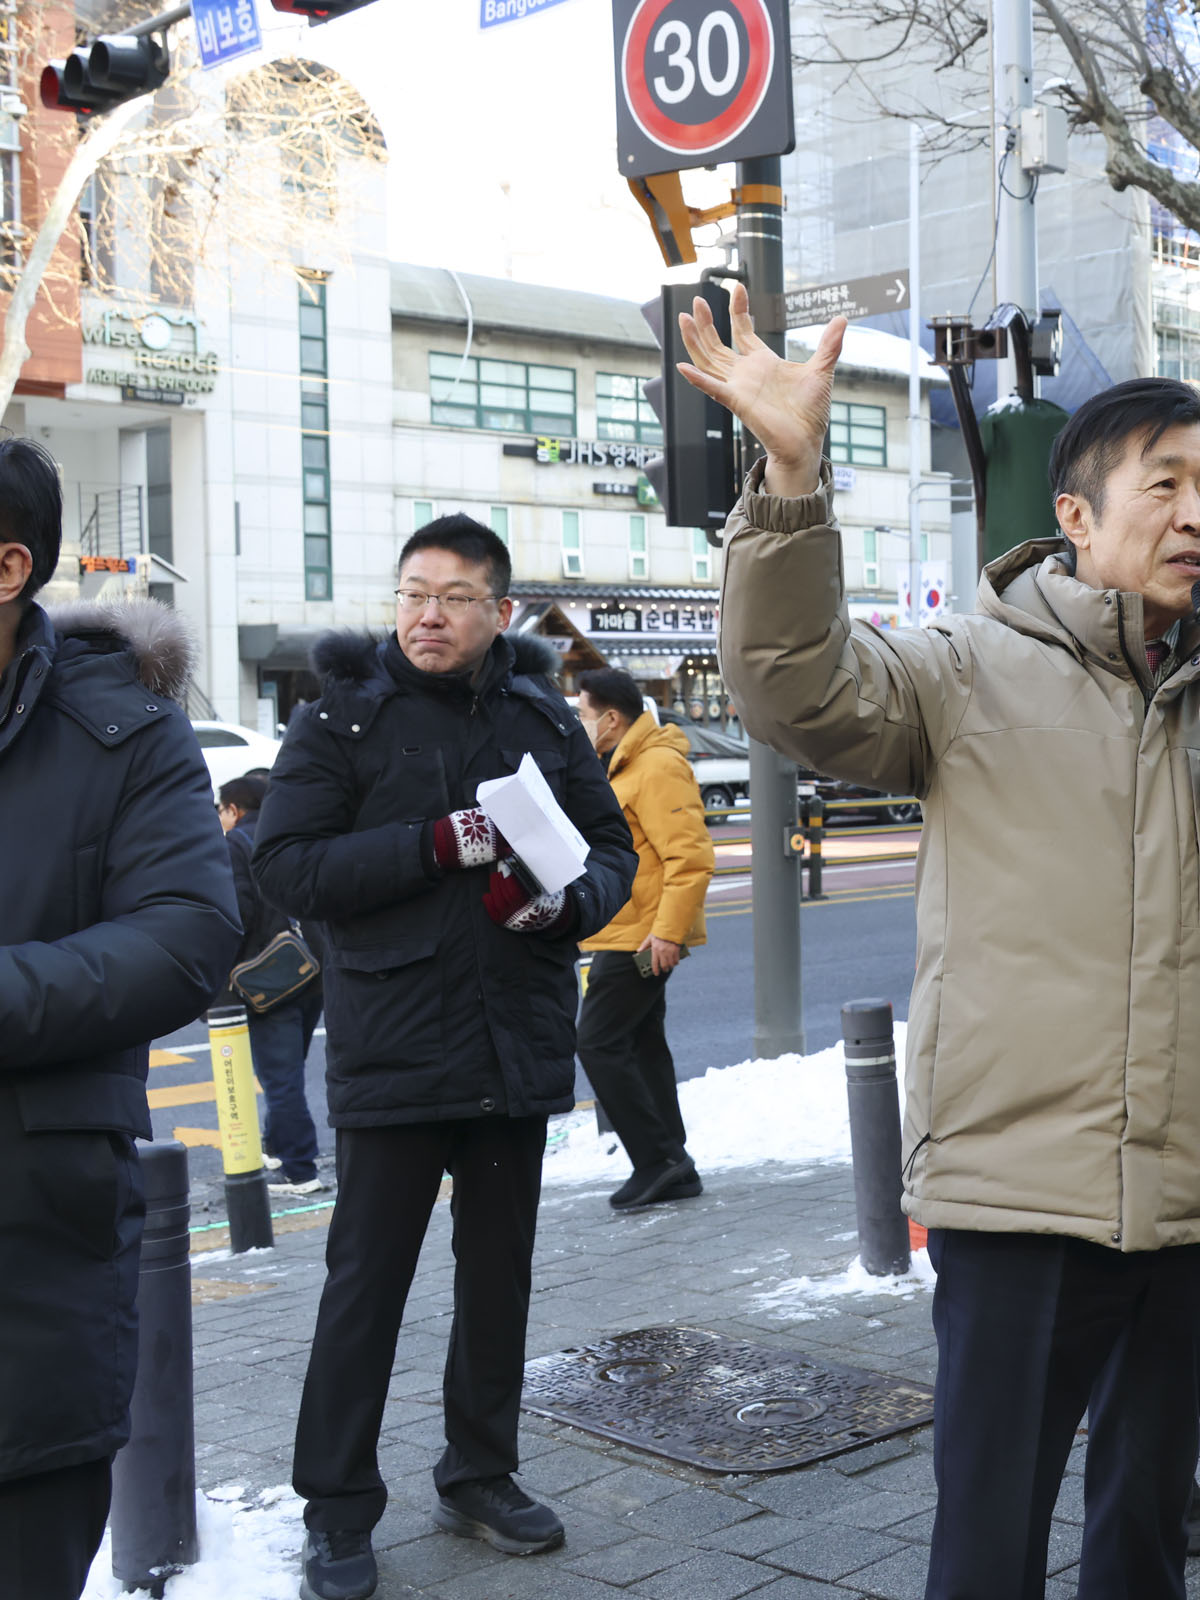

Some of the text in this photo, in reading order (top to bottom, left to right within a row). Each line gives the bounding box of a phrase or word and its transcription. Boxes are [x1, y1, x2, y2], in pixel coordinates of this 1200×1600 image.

[198, 0, 258, 56] 비보호
[653, 10, 740, 104] 30
[595, 609, 715, 630] 가마솥 순대국밥
